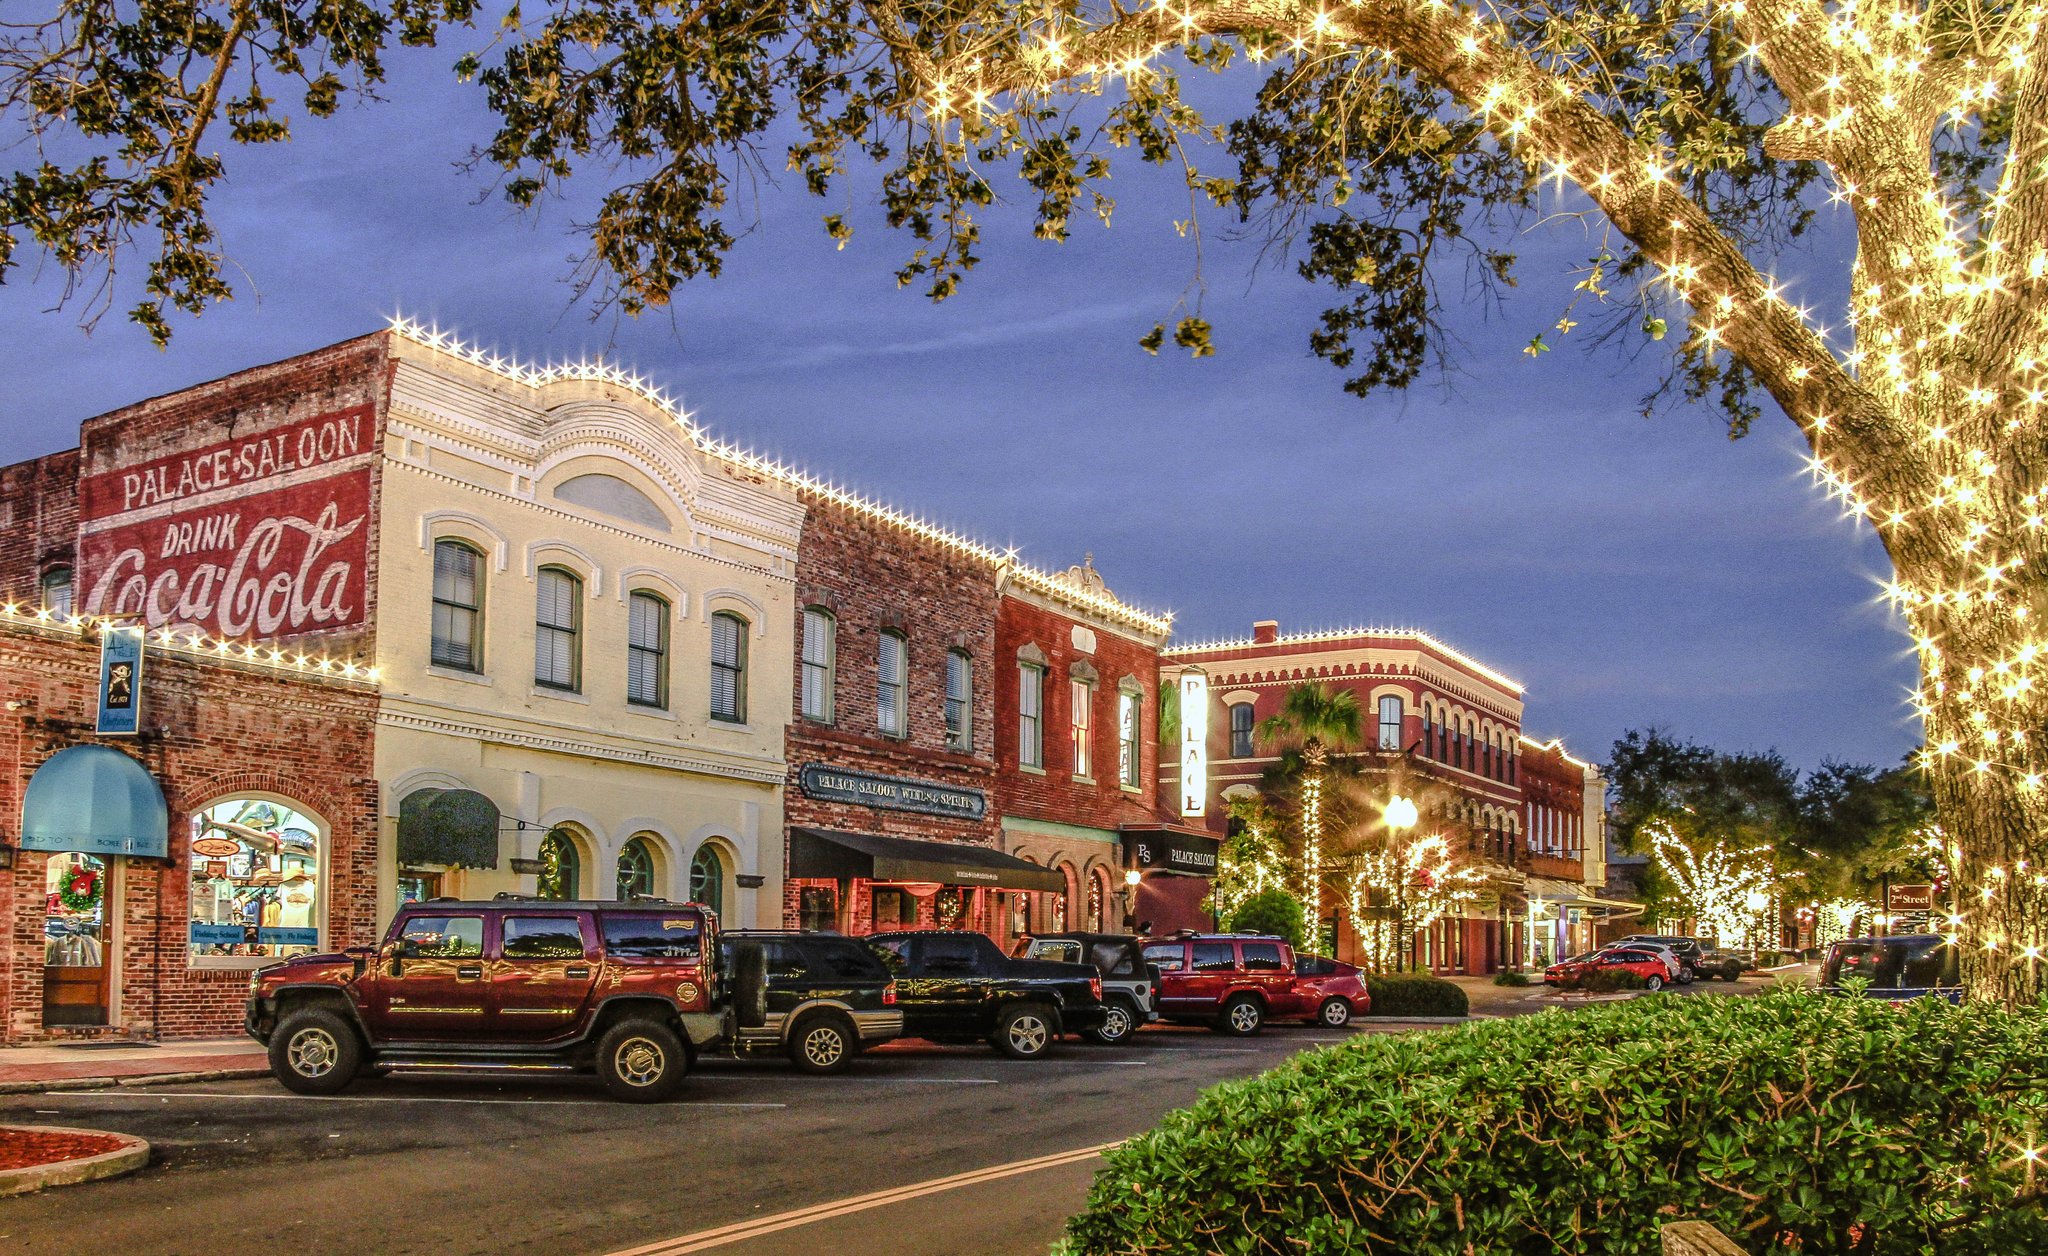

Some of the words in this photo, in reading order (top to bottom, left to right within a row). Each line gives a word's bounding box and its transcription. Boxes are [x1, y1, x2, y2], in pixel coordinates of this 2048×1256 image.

[123, 449, 231, 511] PALACE
[237, 415, 361, 479] SALOON
[161, 513, 241, 559] DRINK
[85, 501, 366, 637] Coca-Cola
[1185, 681, 1201, 811] PLACE
[817, 774, 856, 792] PALACE
[858, 780, 897, 798] SALOON
[901, 787, 930, 802] WINES
[940, 793, 975, 809] SPIRITS
[1171, 848, 1193, 864] PALACE
[1194, 852, 1216, 867] SALOON
[1902, 894, 1929, 904] Street
[194, 930, 218, 940] Fishing
[219, 931, 240, 939] School
